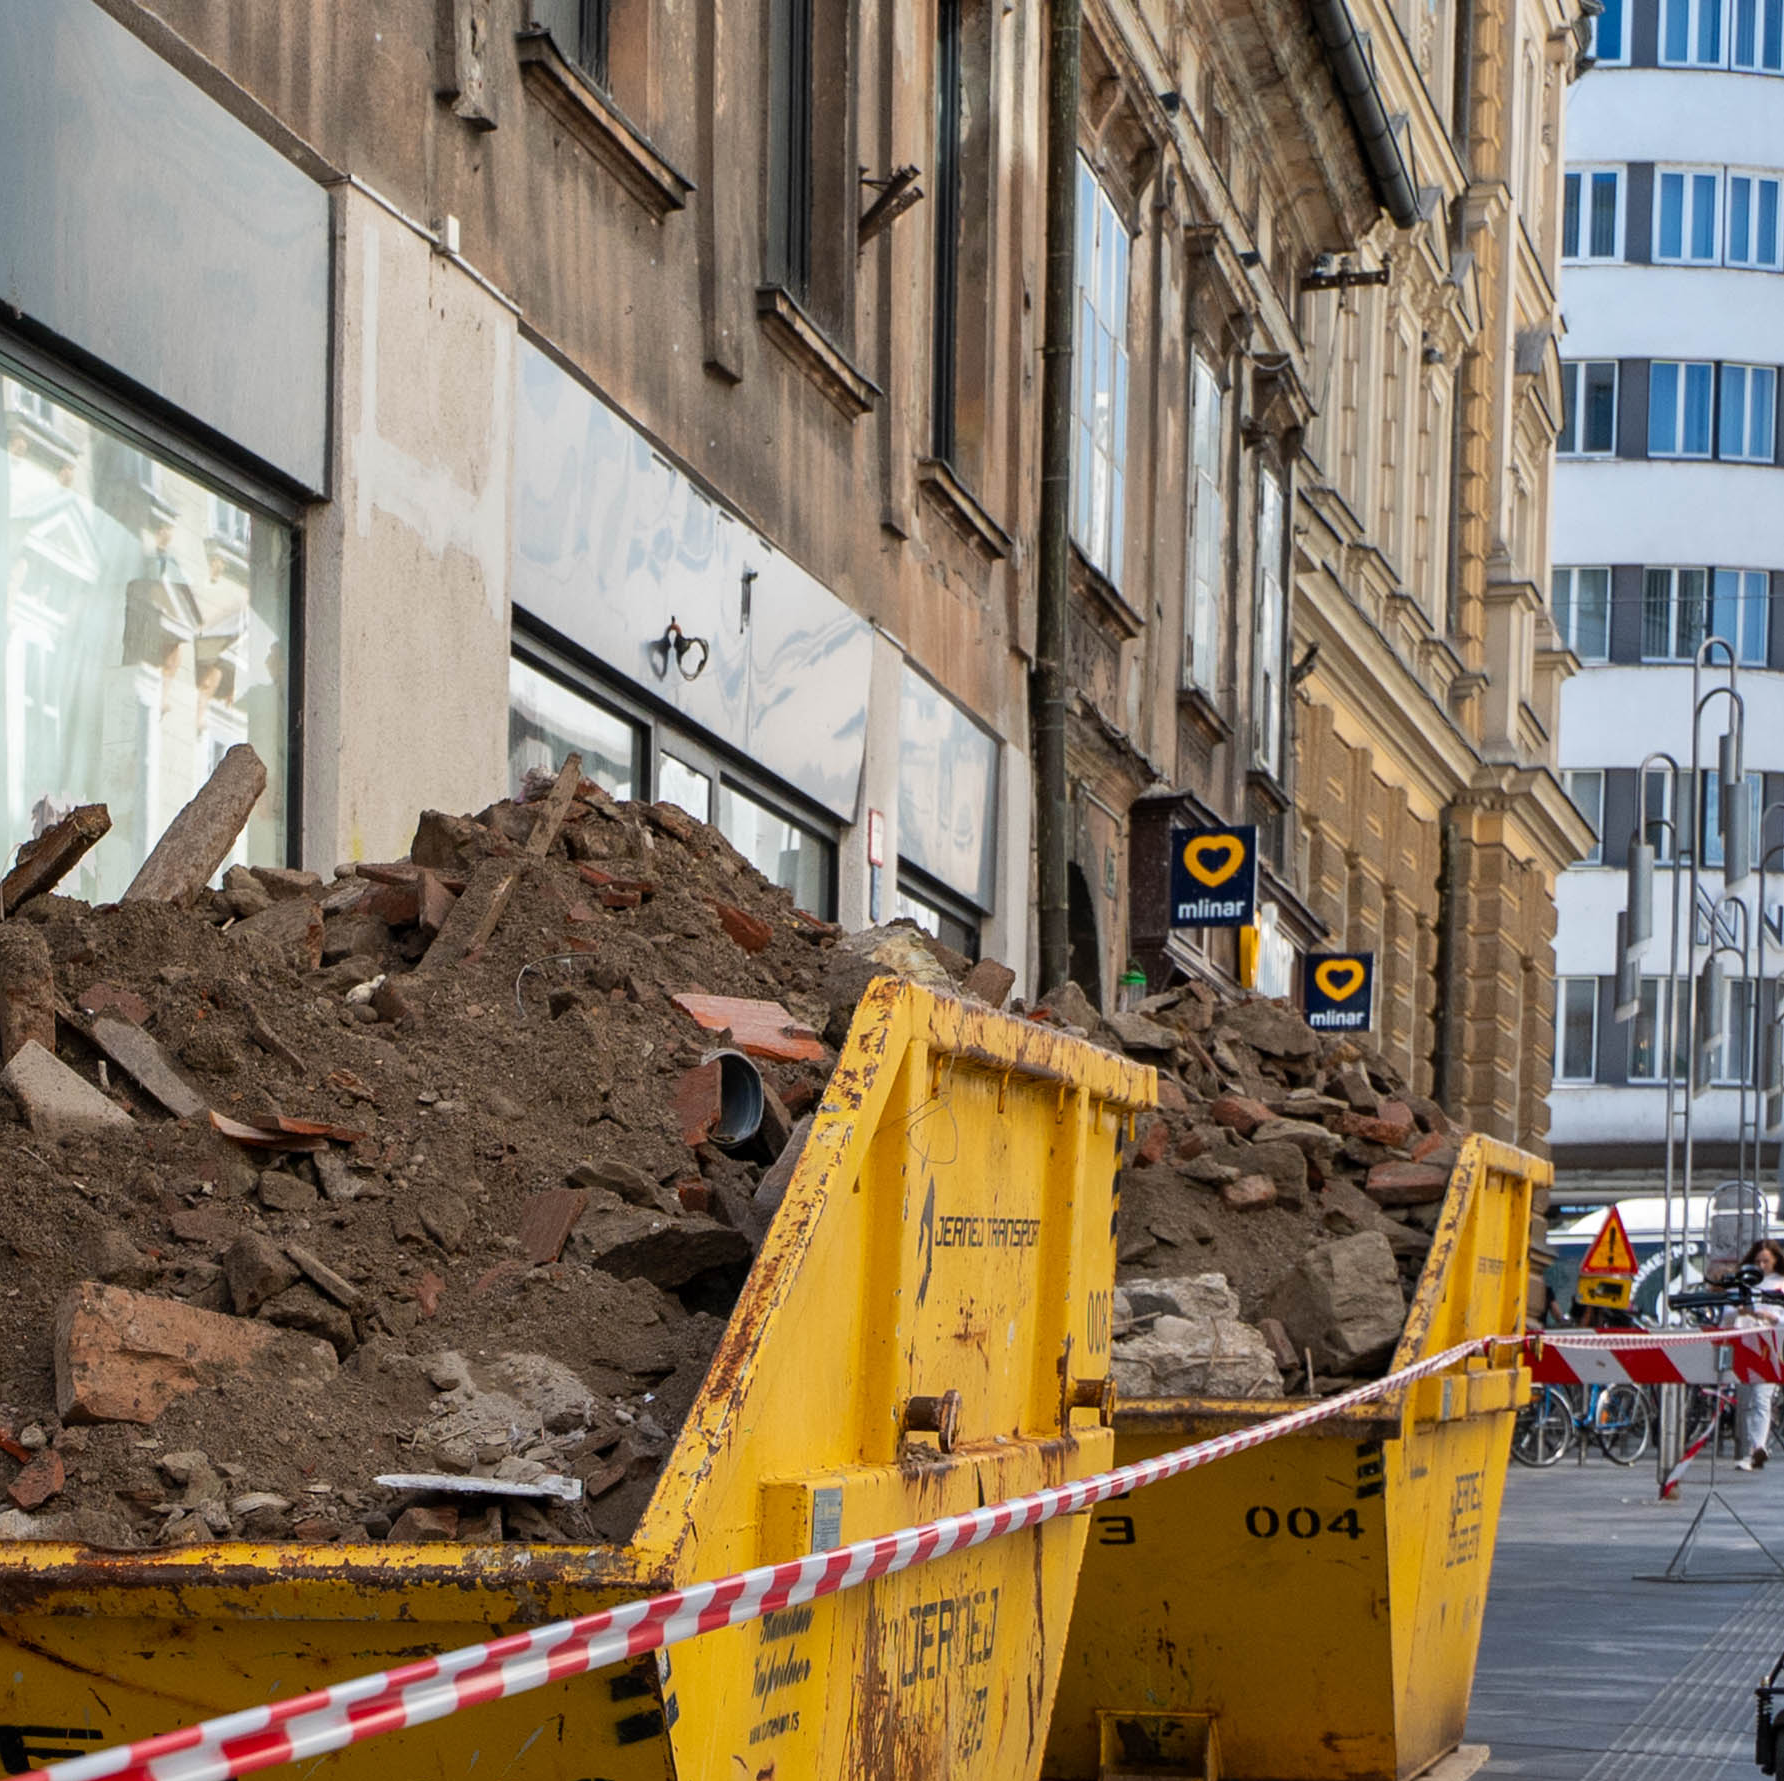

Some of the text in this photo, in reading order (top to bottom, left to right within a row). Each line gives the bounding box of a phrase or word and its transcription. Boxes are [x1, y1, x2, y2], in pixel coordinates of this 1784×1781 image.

[1177, 898, 1247, 920] mlinar
[1309, 1009, 1365, 1027] mlinar
[934, 1216, 985, 1248] JERNEJ
[1245, 1505, 1366, 1541] 004
